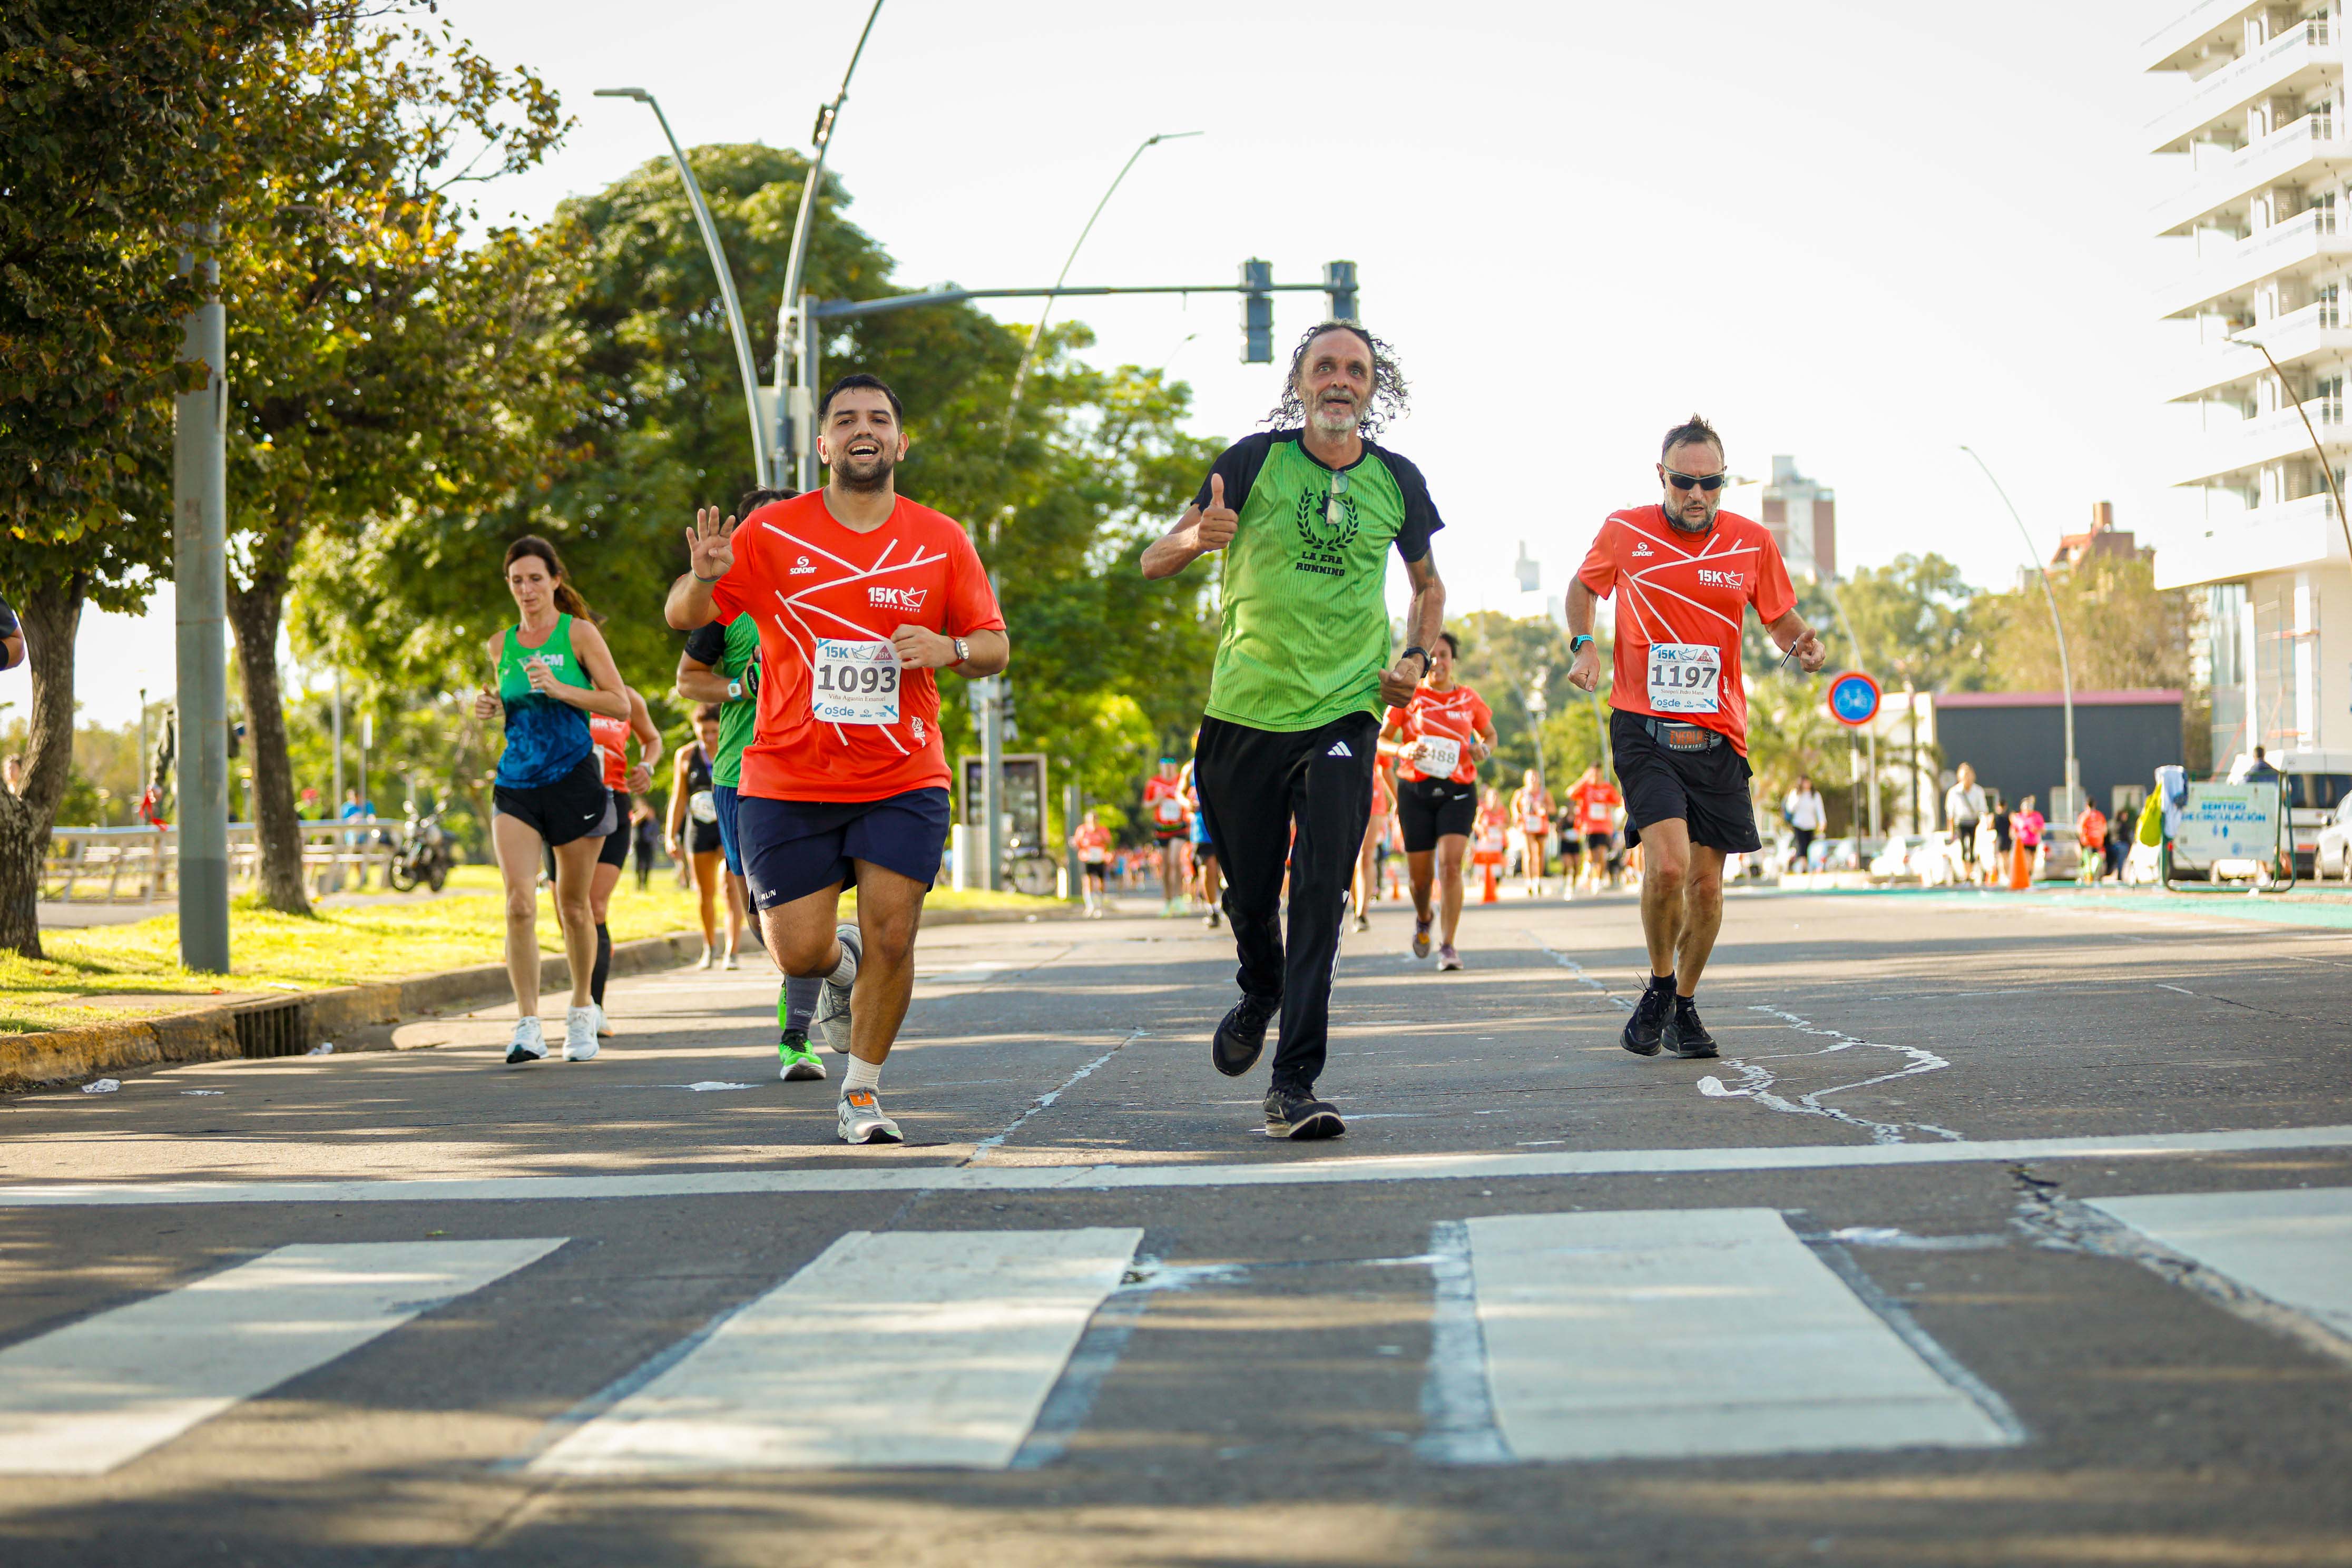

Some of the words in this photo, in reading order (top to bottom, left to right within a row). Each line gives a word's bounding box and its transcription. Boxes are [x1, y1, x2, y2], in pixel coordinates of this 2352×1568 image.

[1301, 551, 1316, 560] LA
[1320, 554, 1342, 564] ERA
[1296, 562, 1345, 576] RUNNING
[1698, 570, 1723, 583] 15K
[868, 587, 899, 603] 15K
[825, 646, 849, 658] 15K
[1657, 650, 1677, 659] 15K
[818, 664, 896, 693] 1093
[1651, 665, 1717, 688] 1197
[1657, 698, 1681, 708] osde
[825, 706, 855, 717] osde
[1670, 730, 1707, 744] EVERLA
[1423, 747, 1456, 764] 488
[761, 889, 776, 901] RUN
